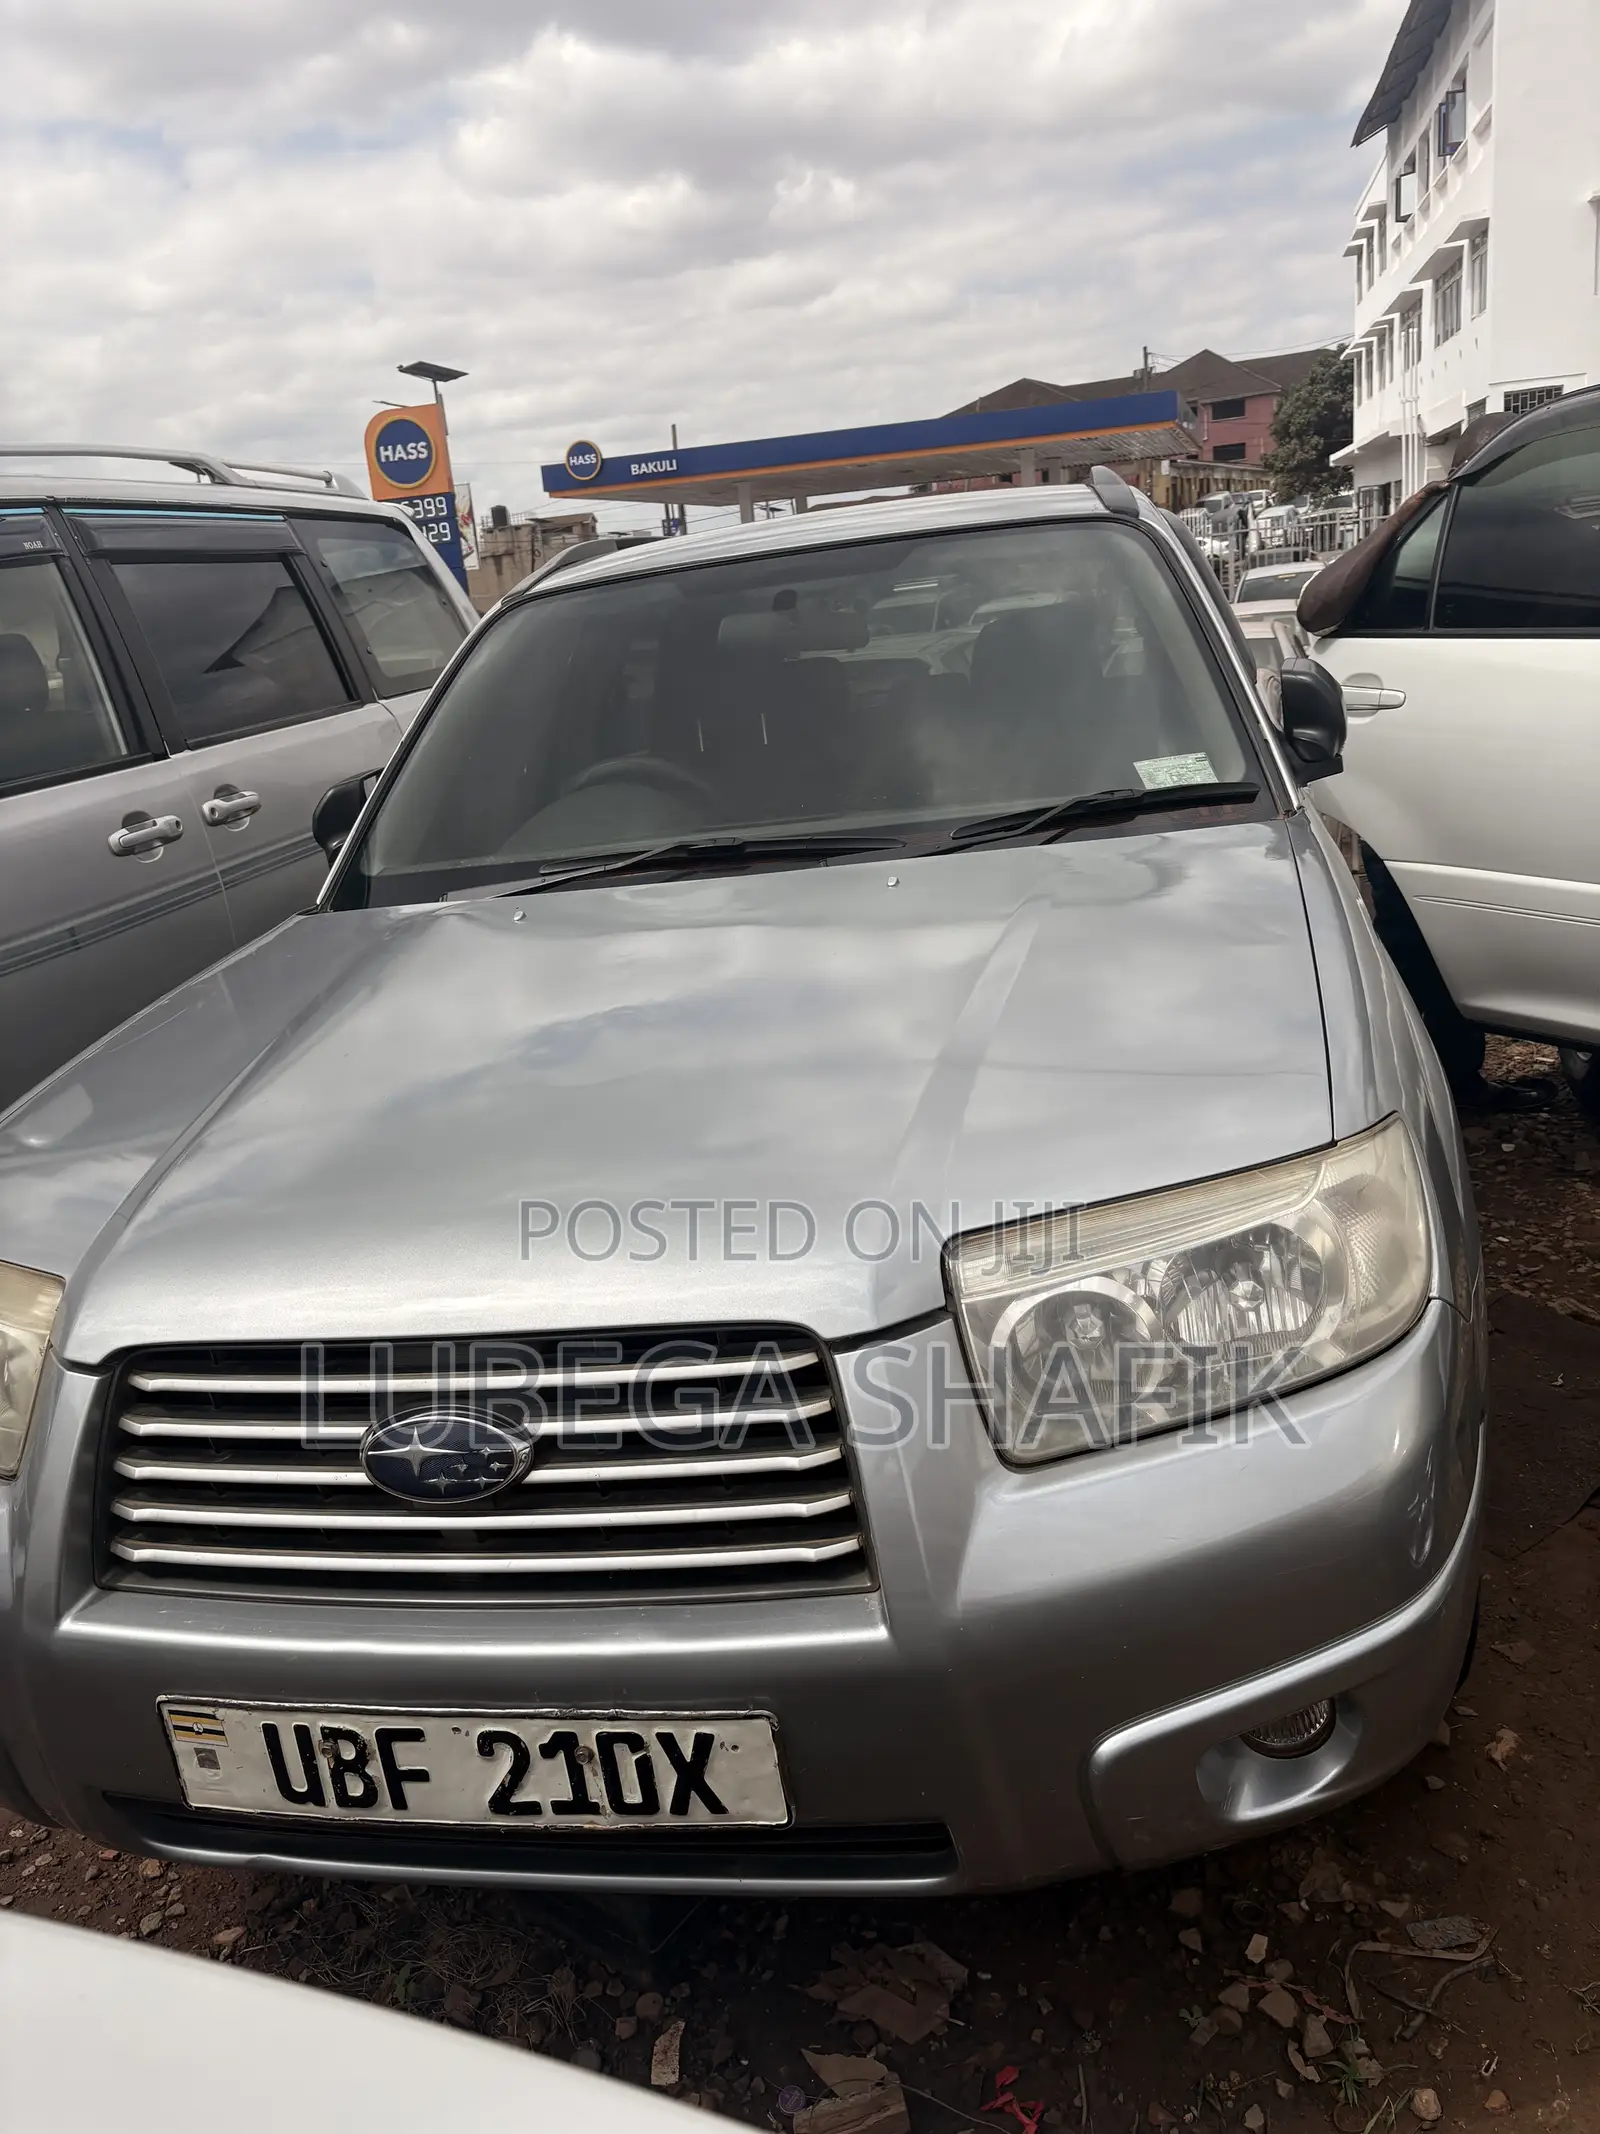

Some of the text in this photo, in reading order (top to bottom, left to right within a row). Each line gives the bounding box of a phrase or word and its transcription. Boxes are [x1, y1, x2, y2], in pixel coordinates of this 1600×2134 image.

[379, 441, 429, 462] HASS
[569, 453, 597, 467] HASS
[630, 459, 678, 476] BAKULI
[22, 540, 44, 550] NOAH
[261, 1721, 731, 1816] UBF 210X
